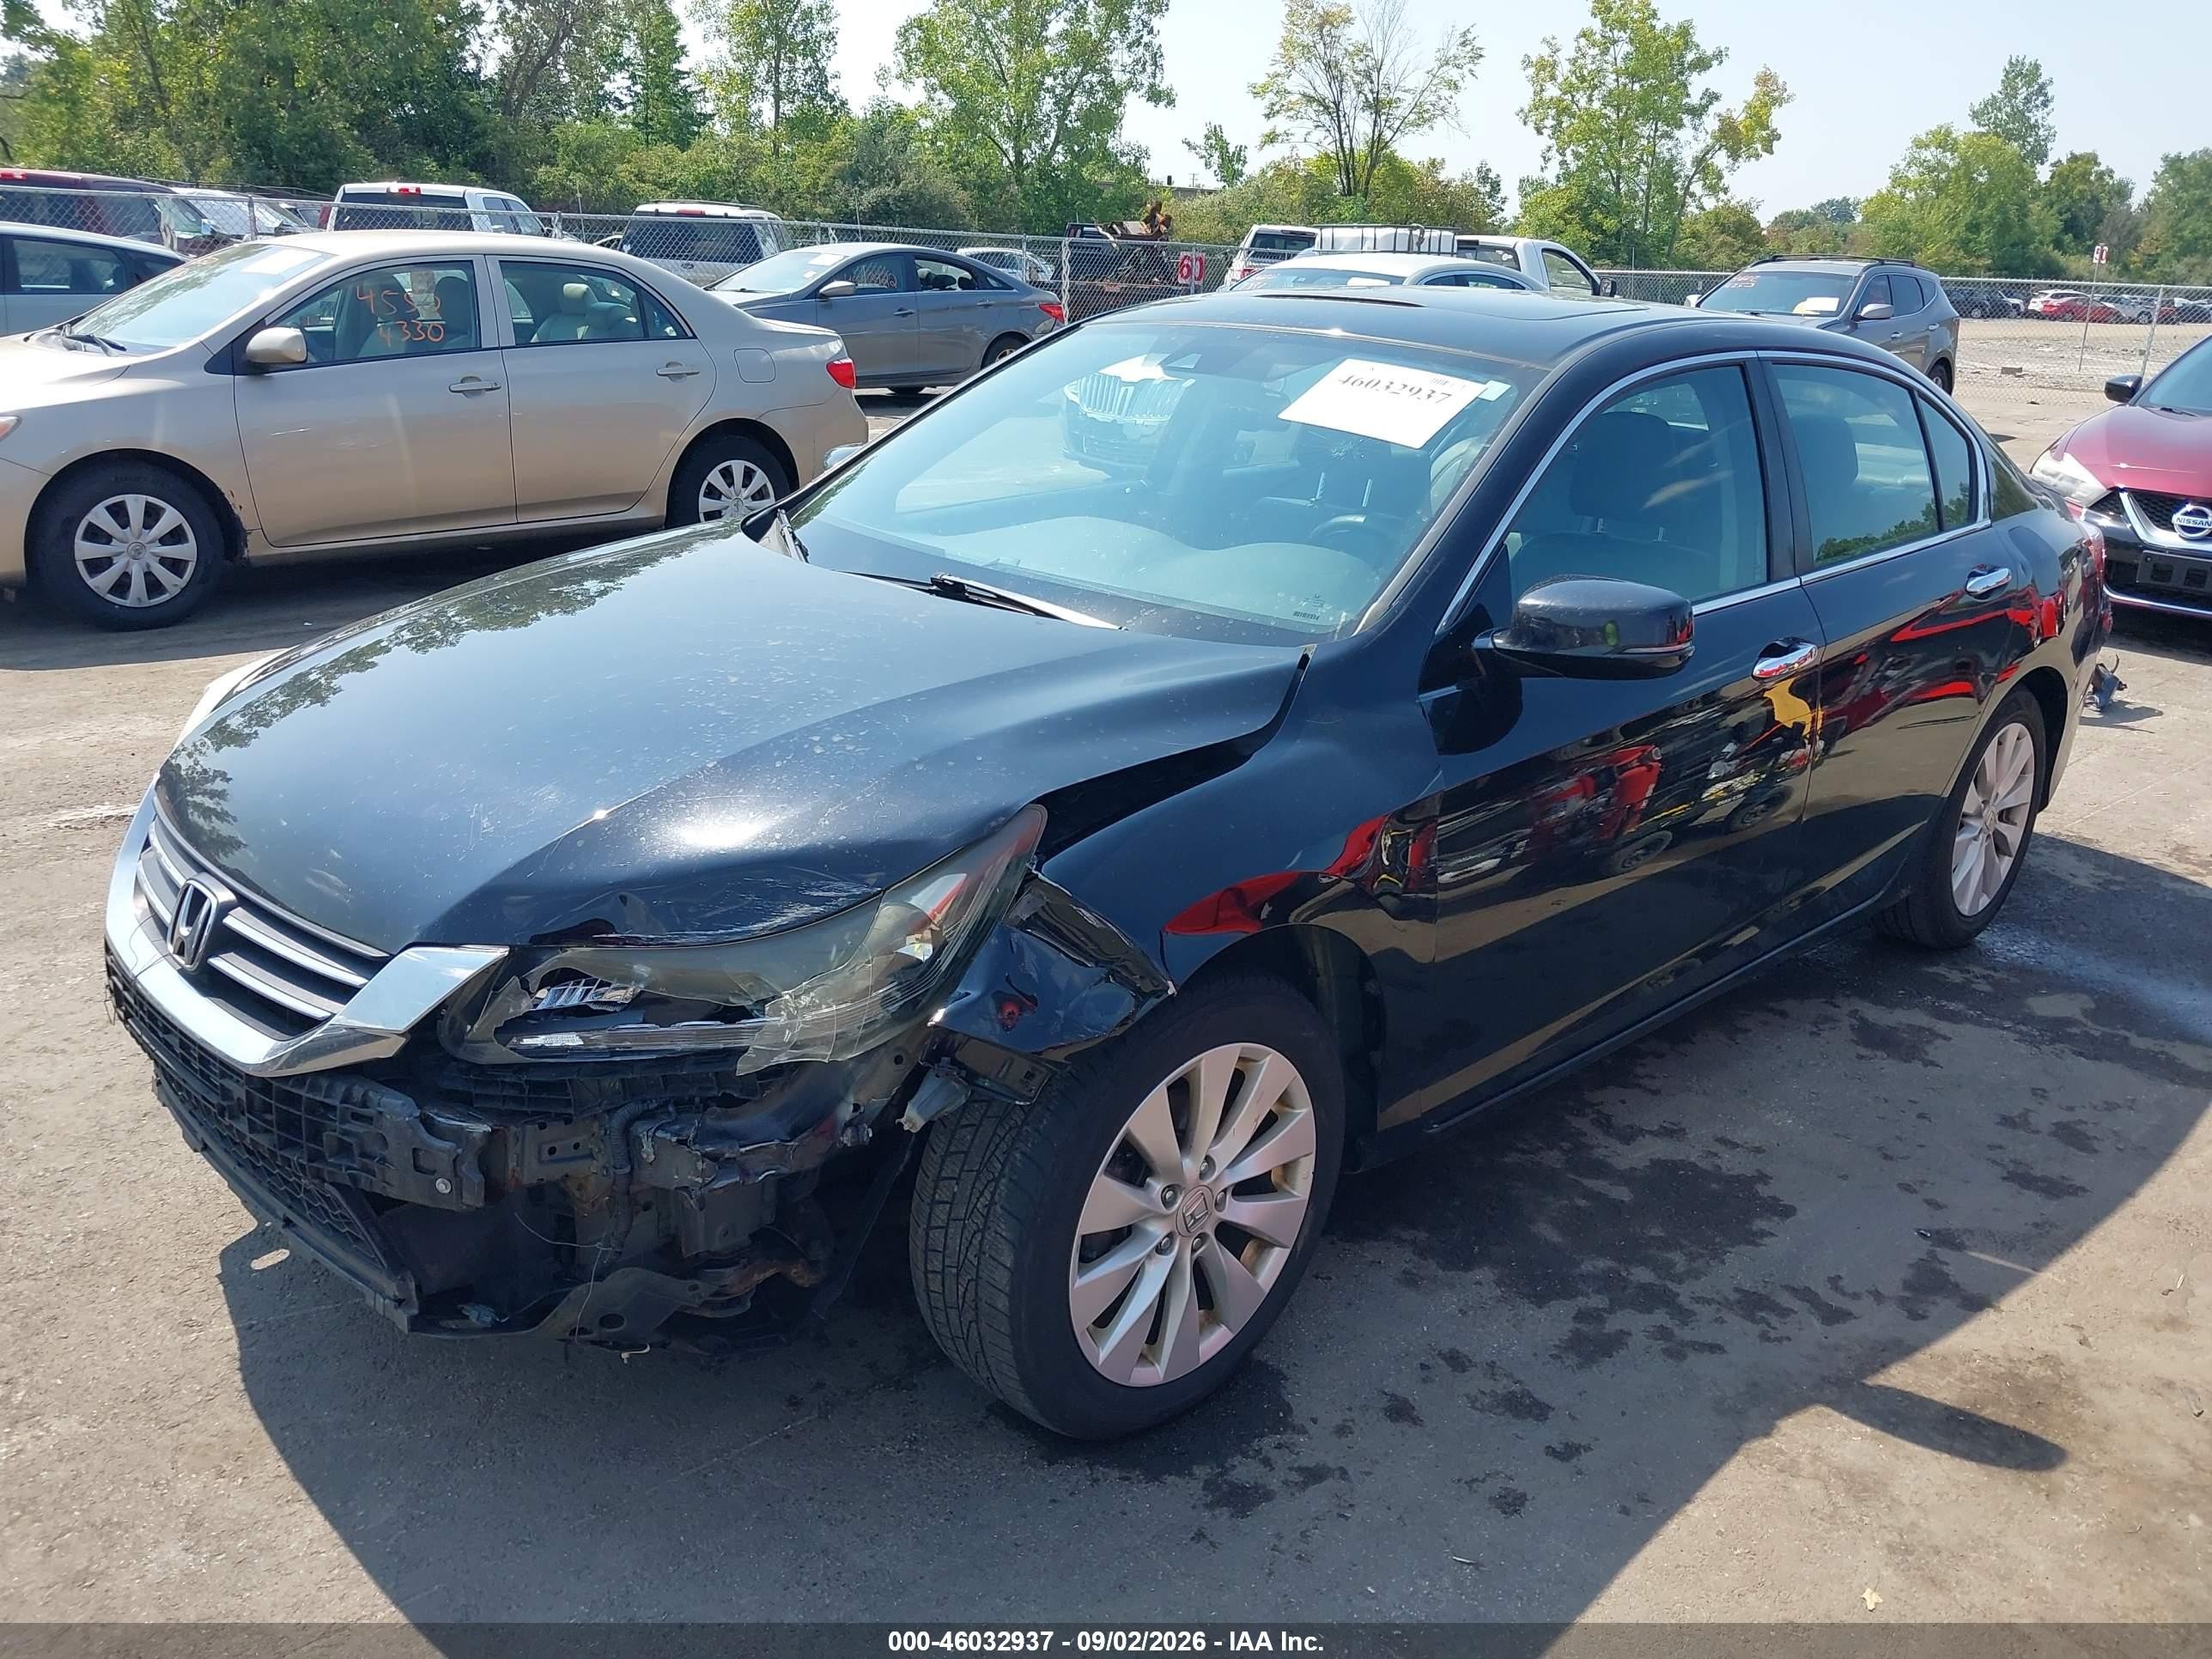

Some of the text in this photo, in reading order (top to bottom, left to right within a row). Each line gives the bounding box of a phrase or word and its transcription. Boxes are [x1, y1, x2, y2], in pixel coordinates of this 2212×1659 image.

[1179, 254, 1204, 282] 60
[379, 319, 444, 348] 4330
[1338, 374, 1453, 404] 46032937
[2176, 517, 2212, 527] NISSAN
